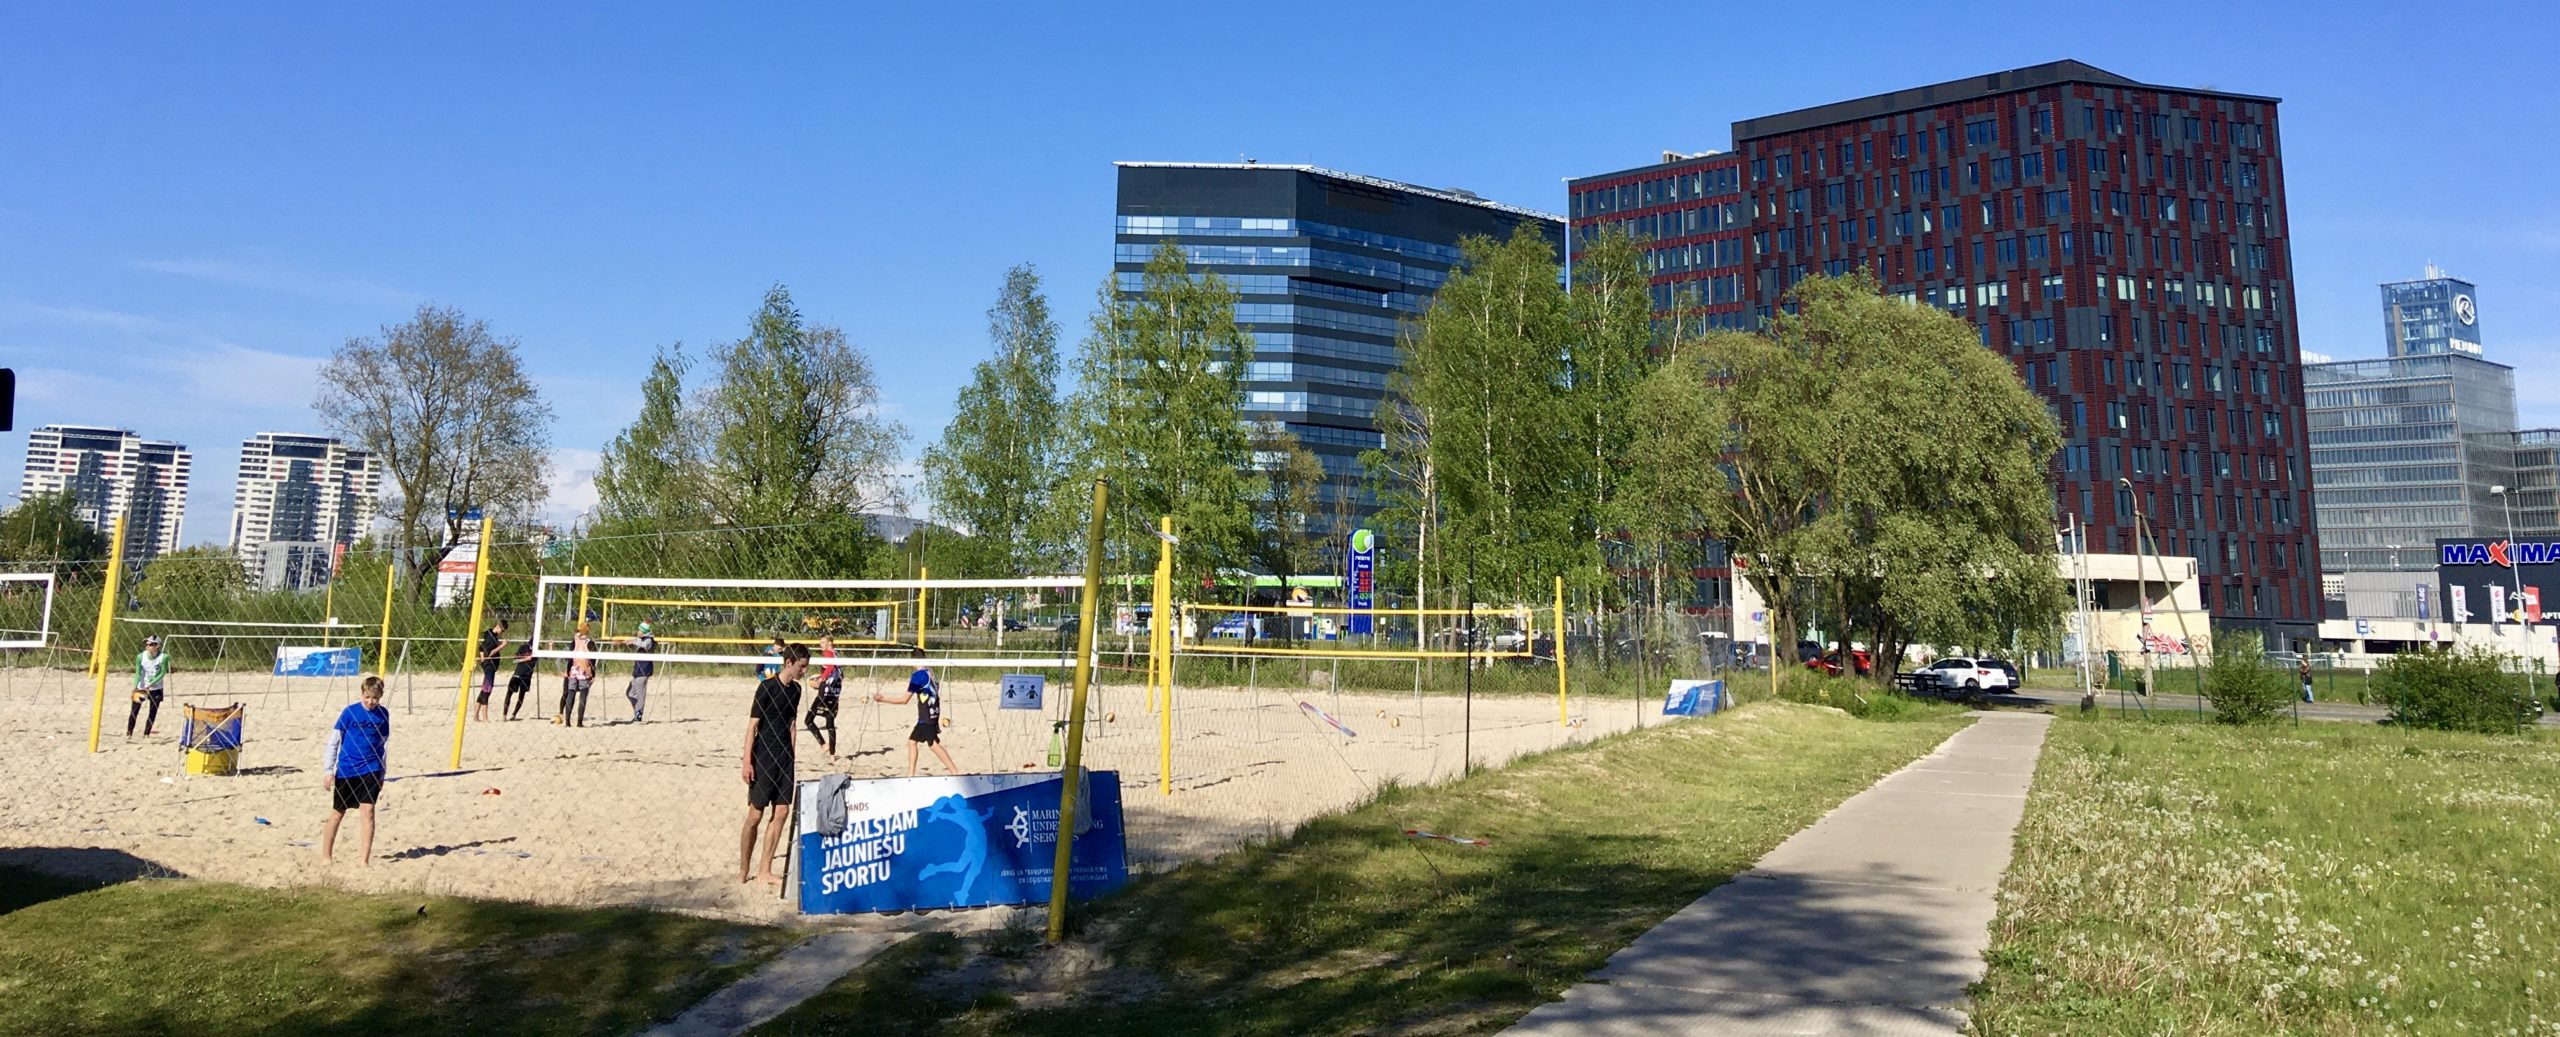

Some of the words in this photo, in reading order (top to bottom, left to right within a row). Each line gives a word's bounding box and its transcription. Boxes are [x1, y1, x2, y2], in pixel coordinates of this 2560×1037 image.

[2442, 540, 2560, 568] MAXIMA
[821, 833, 905, 872] JAUNIEŠU
[821, 859, 891, 895] SPORTU
